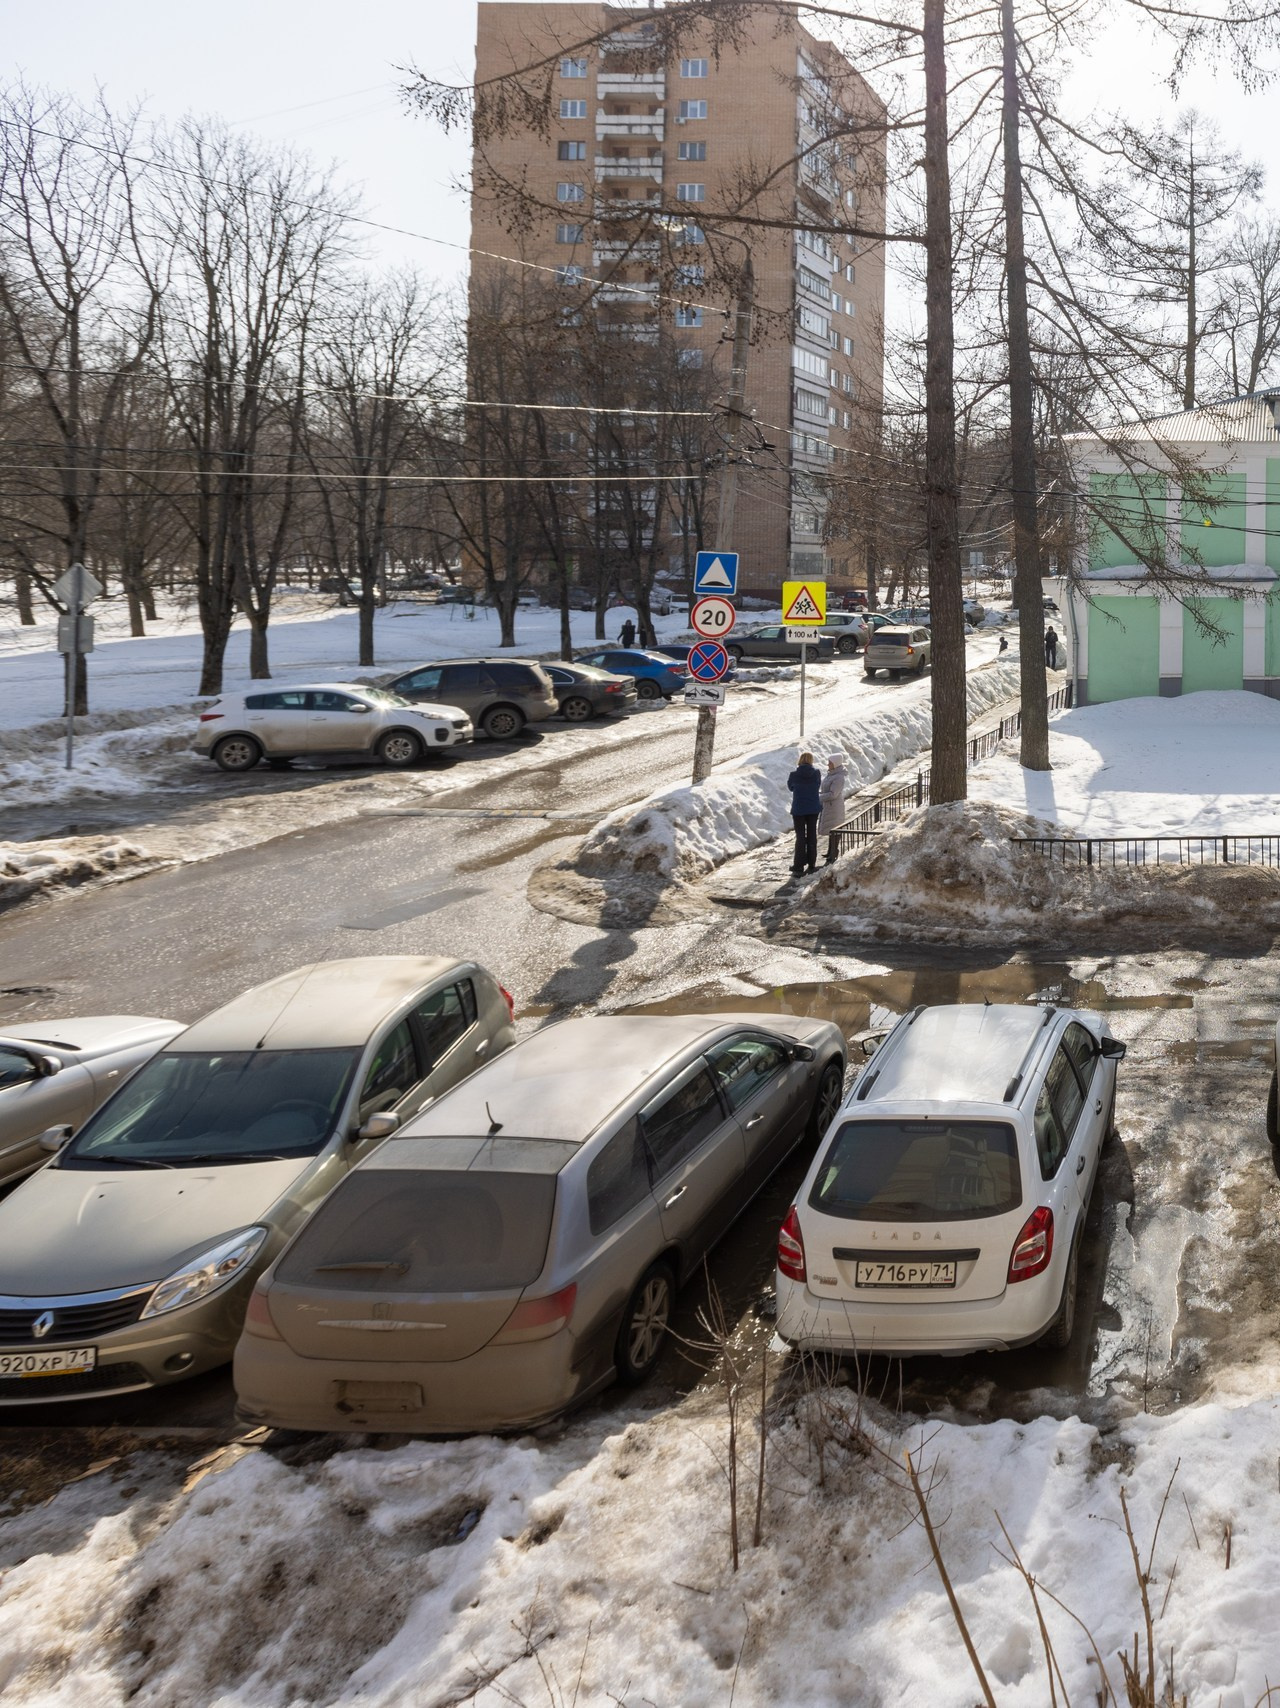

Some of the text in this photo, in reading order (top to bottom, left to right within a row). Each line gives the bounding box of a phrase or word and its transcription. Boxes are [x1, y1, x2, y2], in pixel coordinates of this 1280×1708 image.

[701, 609, 726, 626] 20
[871, 1230, 942, 1241] LADA
[933, 1264, 949, 1277] 71
[69, 1350, 89, 1363] 71
